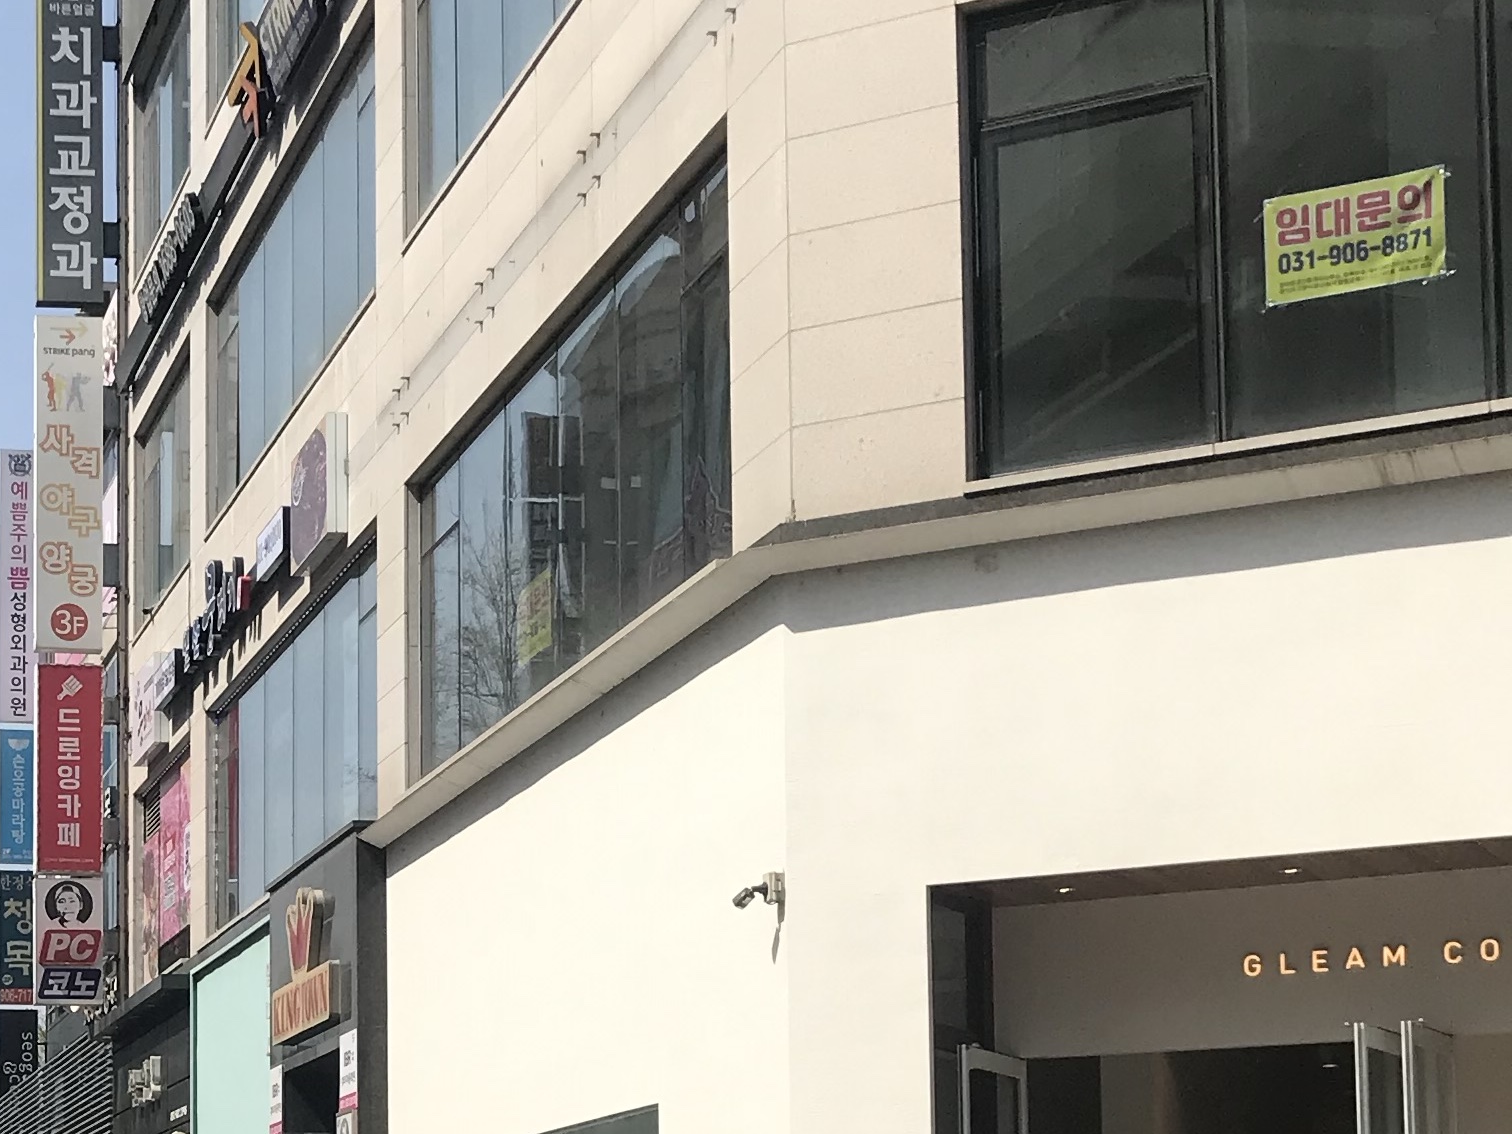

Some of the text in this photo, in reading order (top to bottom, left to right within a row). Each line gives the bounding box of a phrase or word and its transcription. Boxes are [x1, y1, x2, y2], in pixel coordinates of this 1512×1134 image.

[49, 26, 97, 290] 치과교정과
[1275, 179, 1434, 247] 임대문의
[1278, 226, 1433, 275] 031-906-8871
[71, 348, 95, 358] pang
[39, 424, 101, 480] 사격
[39, 482, 101, 538] 야구
[39, 542, 99, 597] 양궁
[55, 609, 86, 635] 3F
[46, 933, 96, 961] PC
[1243, 938, 1500, 977] GLEAM CO
[44, 971, 95, 997] 코노
[273, 971, 329, 1038] KINGTOWN
